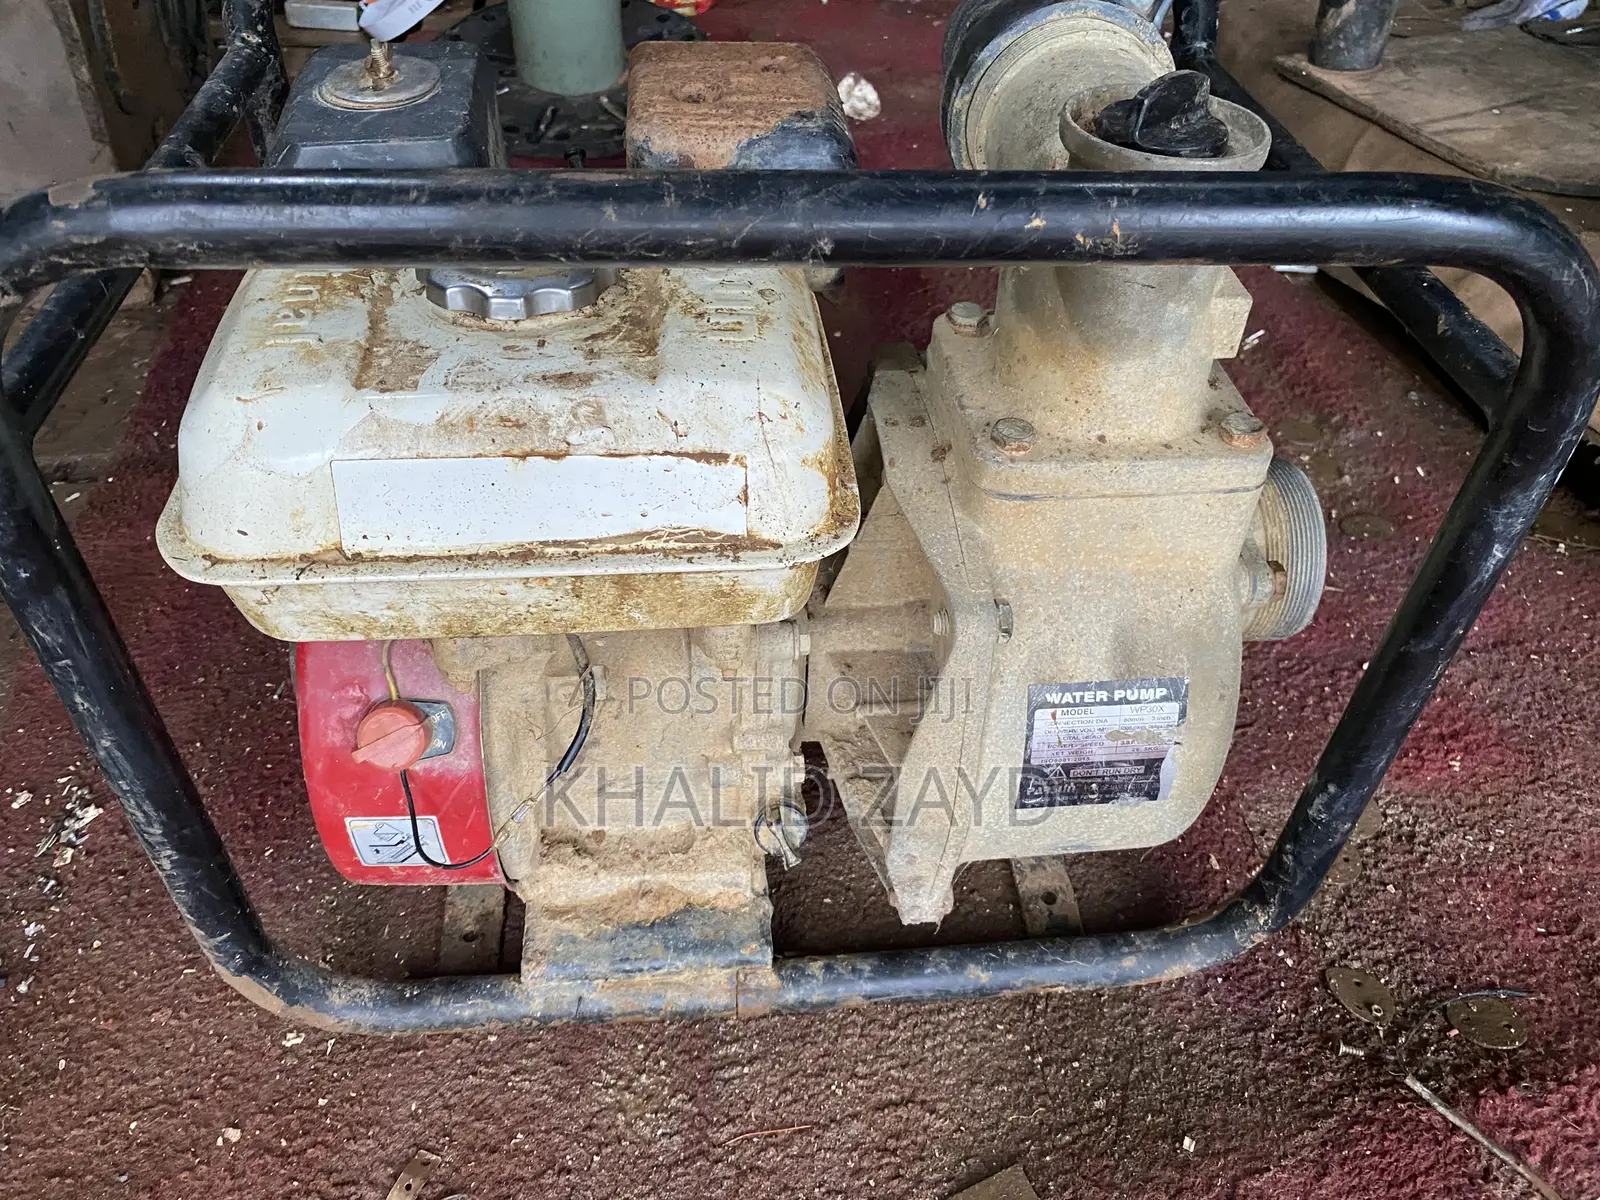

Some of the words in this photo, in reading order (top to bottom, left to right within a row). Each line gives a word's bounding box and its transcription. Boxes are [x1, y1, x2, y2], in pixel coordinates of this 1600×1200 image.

[1045, 690, 1109, 704] WATER
[1114, 688, 1167, 702] PUMP
[1060, 709, 1095, 717] MODEL
[1129, 704, 1165, 714] WP30X
[1072, 768, 1100, 777] DON'T
[1102, 767, 1122, 775] RUN
[1123, 766, 1143, 774] DRY
